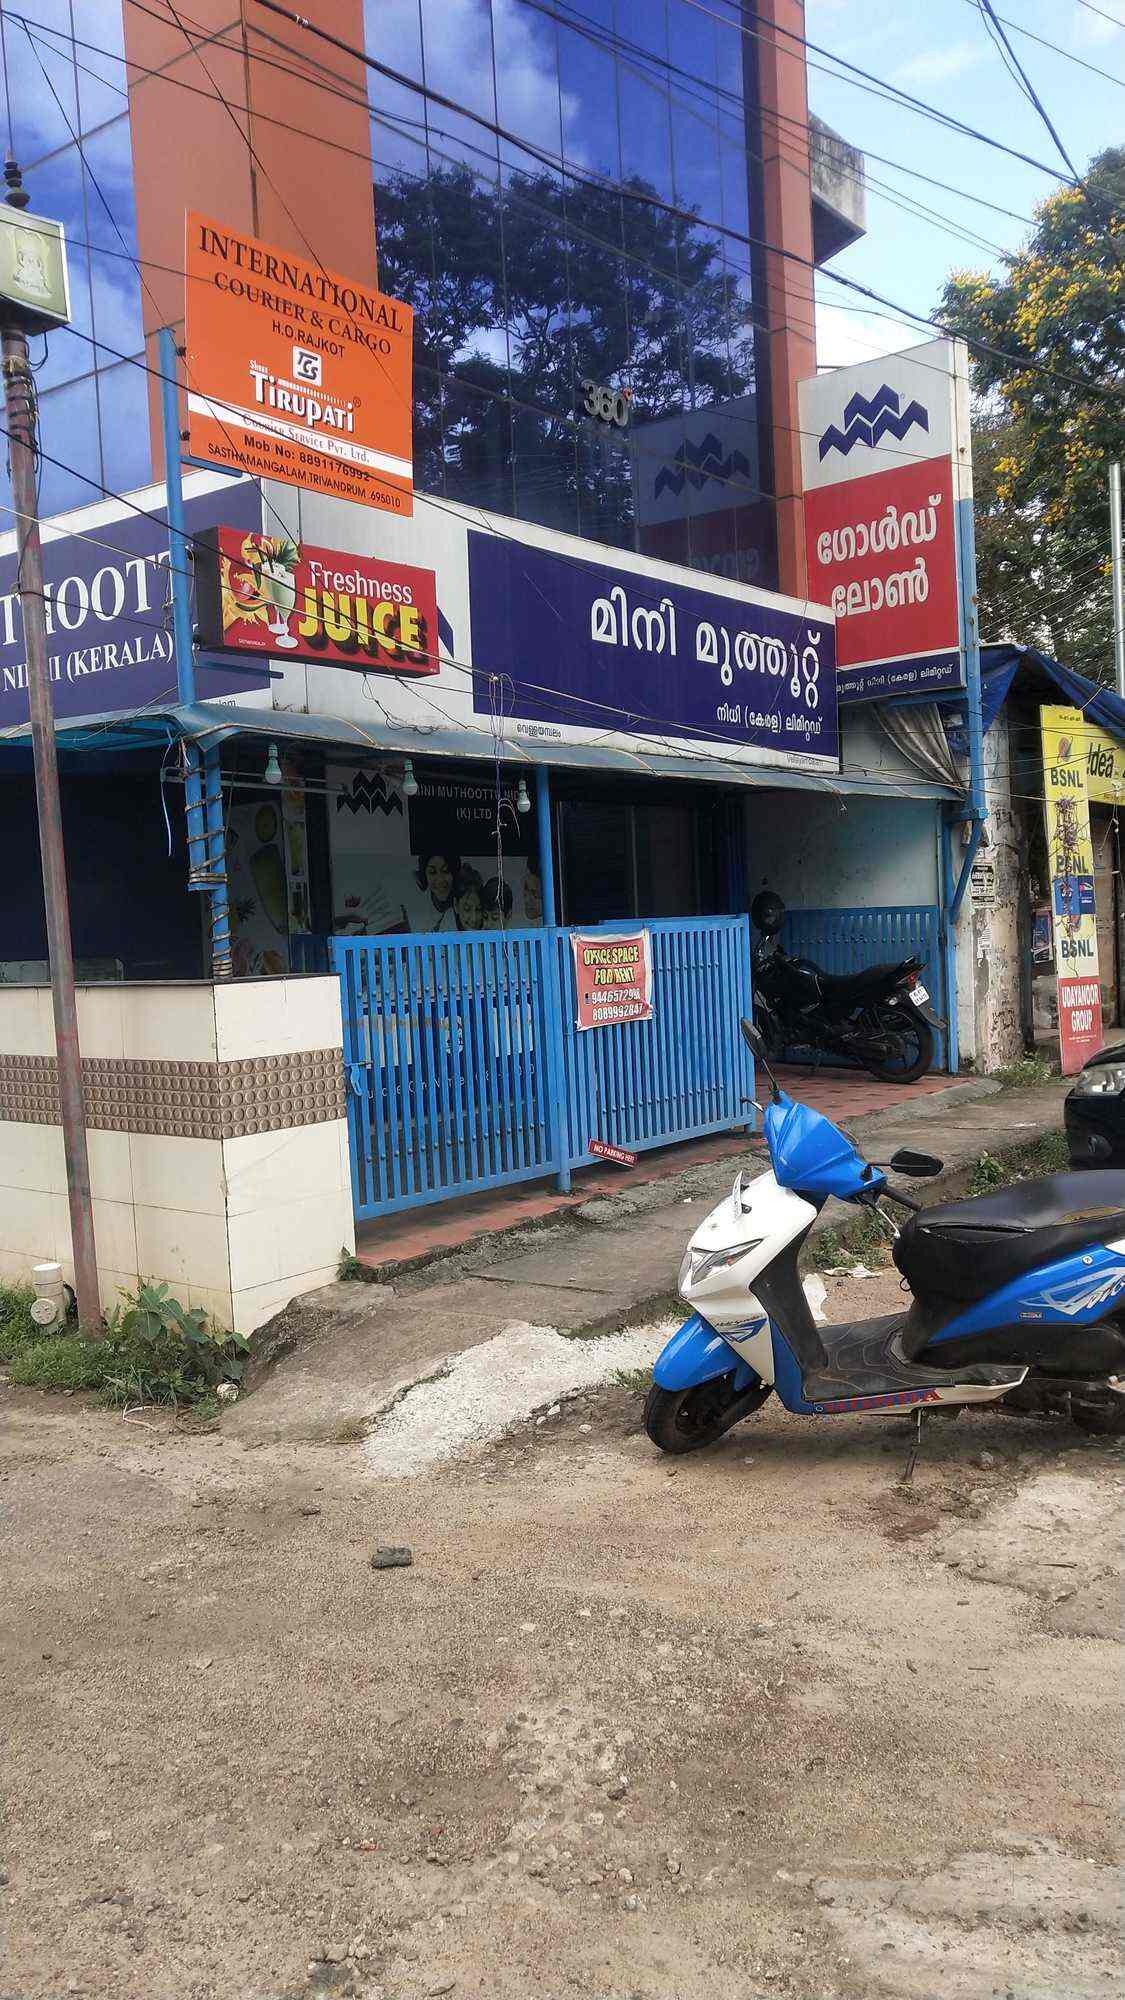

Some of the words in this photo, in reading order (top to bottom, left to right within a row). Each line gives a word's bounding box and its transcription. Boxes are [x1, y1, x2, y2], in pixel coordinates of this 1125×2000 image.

[199, 225, 403, 333] INTERNATIONAL
[214, 271, 305, 323] COURIER
[311, 310, 323, 329] &
[328, 317, 391, 355] CARGO
[244, 434, 270, 452] Mob
[275, 442, 296, 460] No:
[299, 451, 371, 482] 8891176992
[817, 493, 942, 564] ഗോൾഡ്
[309, 560, 412, 604] Freshness
[831, 556, 929, 617] ലോൺ
[298, 586, 422, 650] JUICE
[591, 585, 677, 656] മിനി
[66, 631, 174, 683] (KERALA)
[1050, 767, 1084, 788] BSNL
[584, 947, 611, 966] OFFICE
[612, 944, 640, 964] SPACE
[1061, 939, 1094, 959] BSNL
[593, 968, 614, 985] FOR
[1071, 1009, 1093, 1032] GROUP
[593, 1144, 604, 1153] NO
